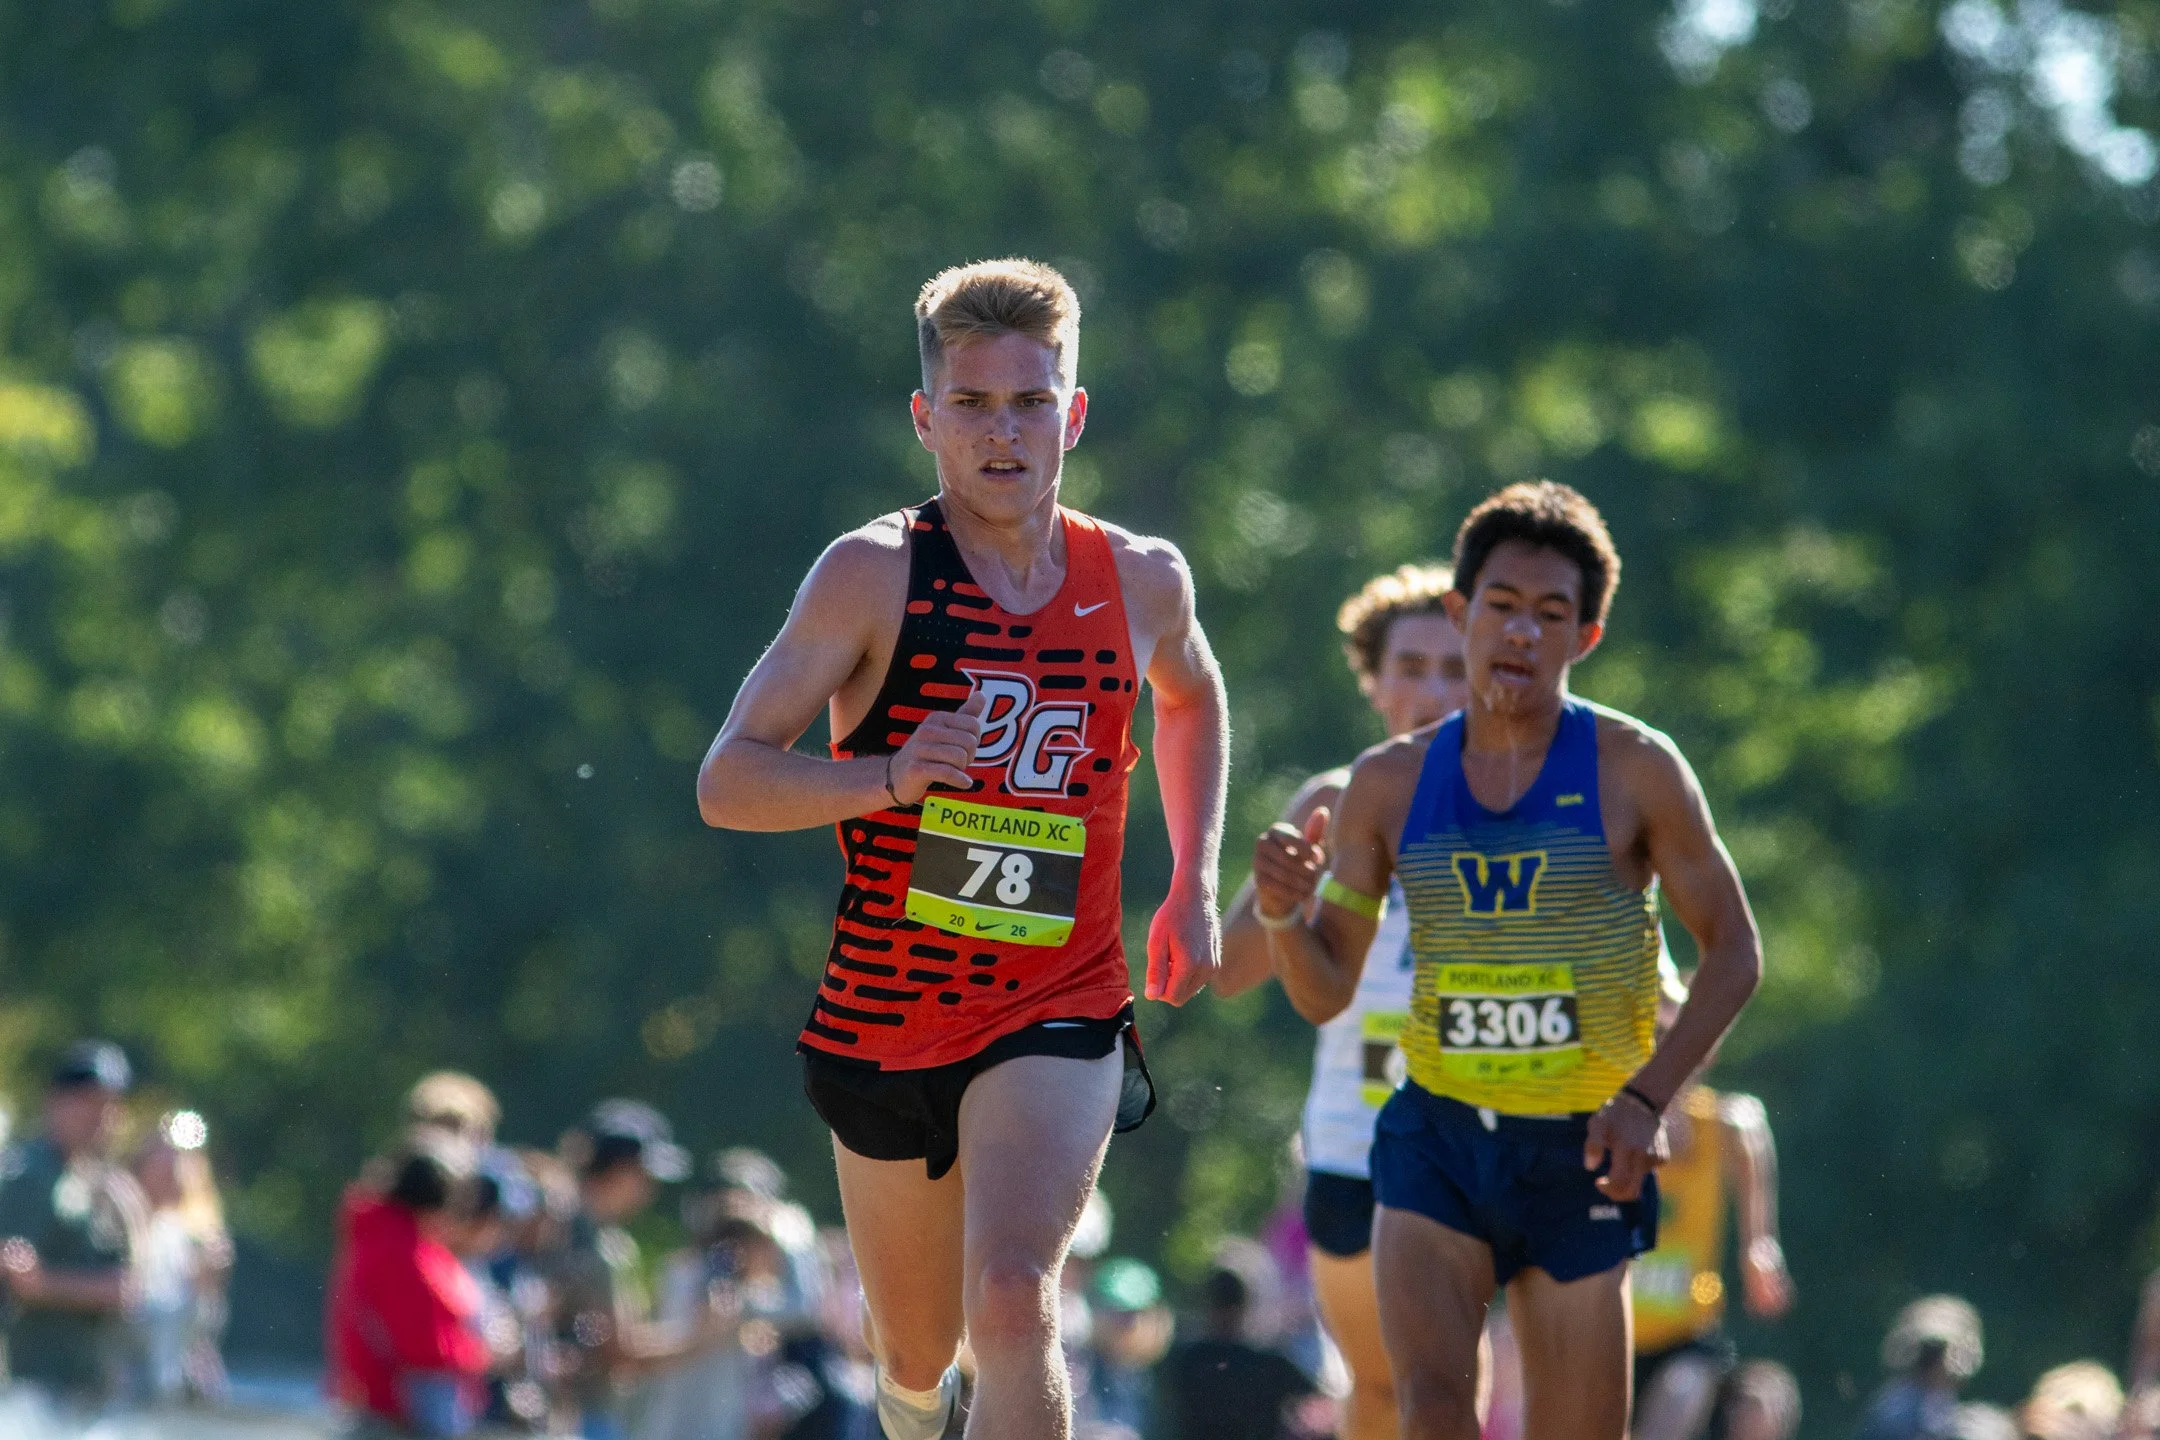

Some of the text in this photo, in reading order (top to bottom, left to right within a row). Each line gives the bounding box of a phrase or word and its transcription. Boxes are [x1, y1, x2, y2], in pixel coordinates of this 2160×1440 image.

[960, 667, 1095, 799] BG
[940, 807, 1071, 842] PORTLAND XC
[957, 847, 1034, 905] 78
[1451, 849, 1548, 919] W
[949, 913, 965, 928] 20
[1009, 924, 1028, 938] 26
[1446, 998, 1573, 1047] 3306
